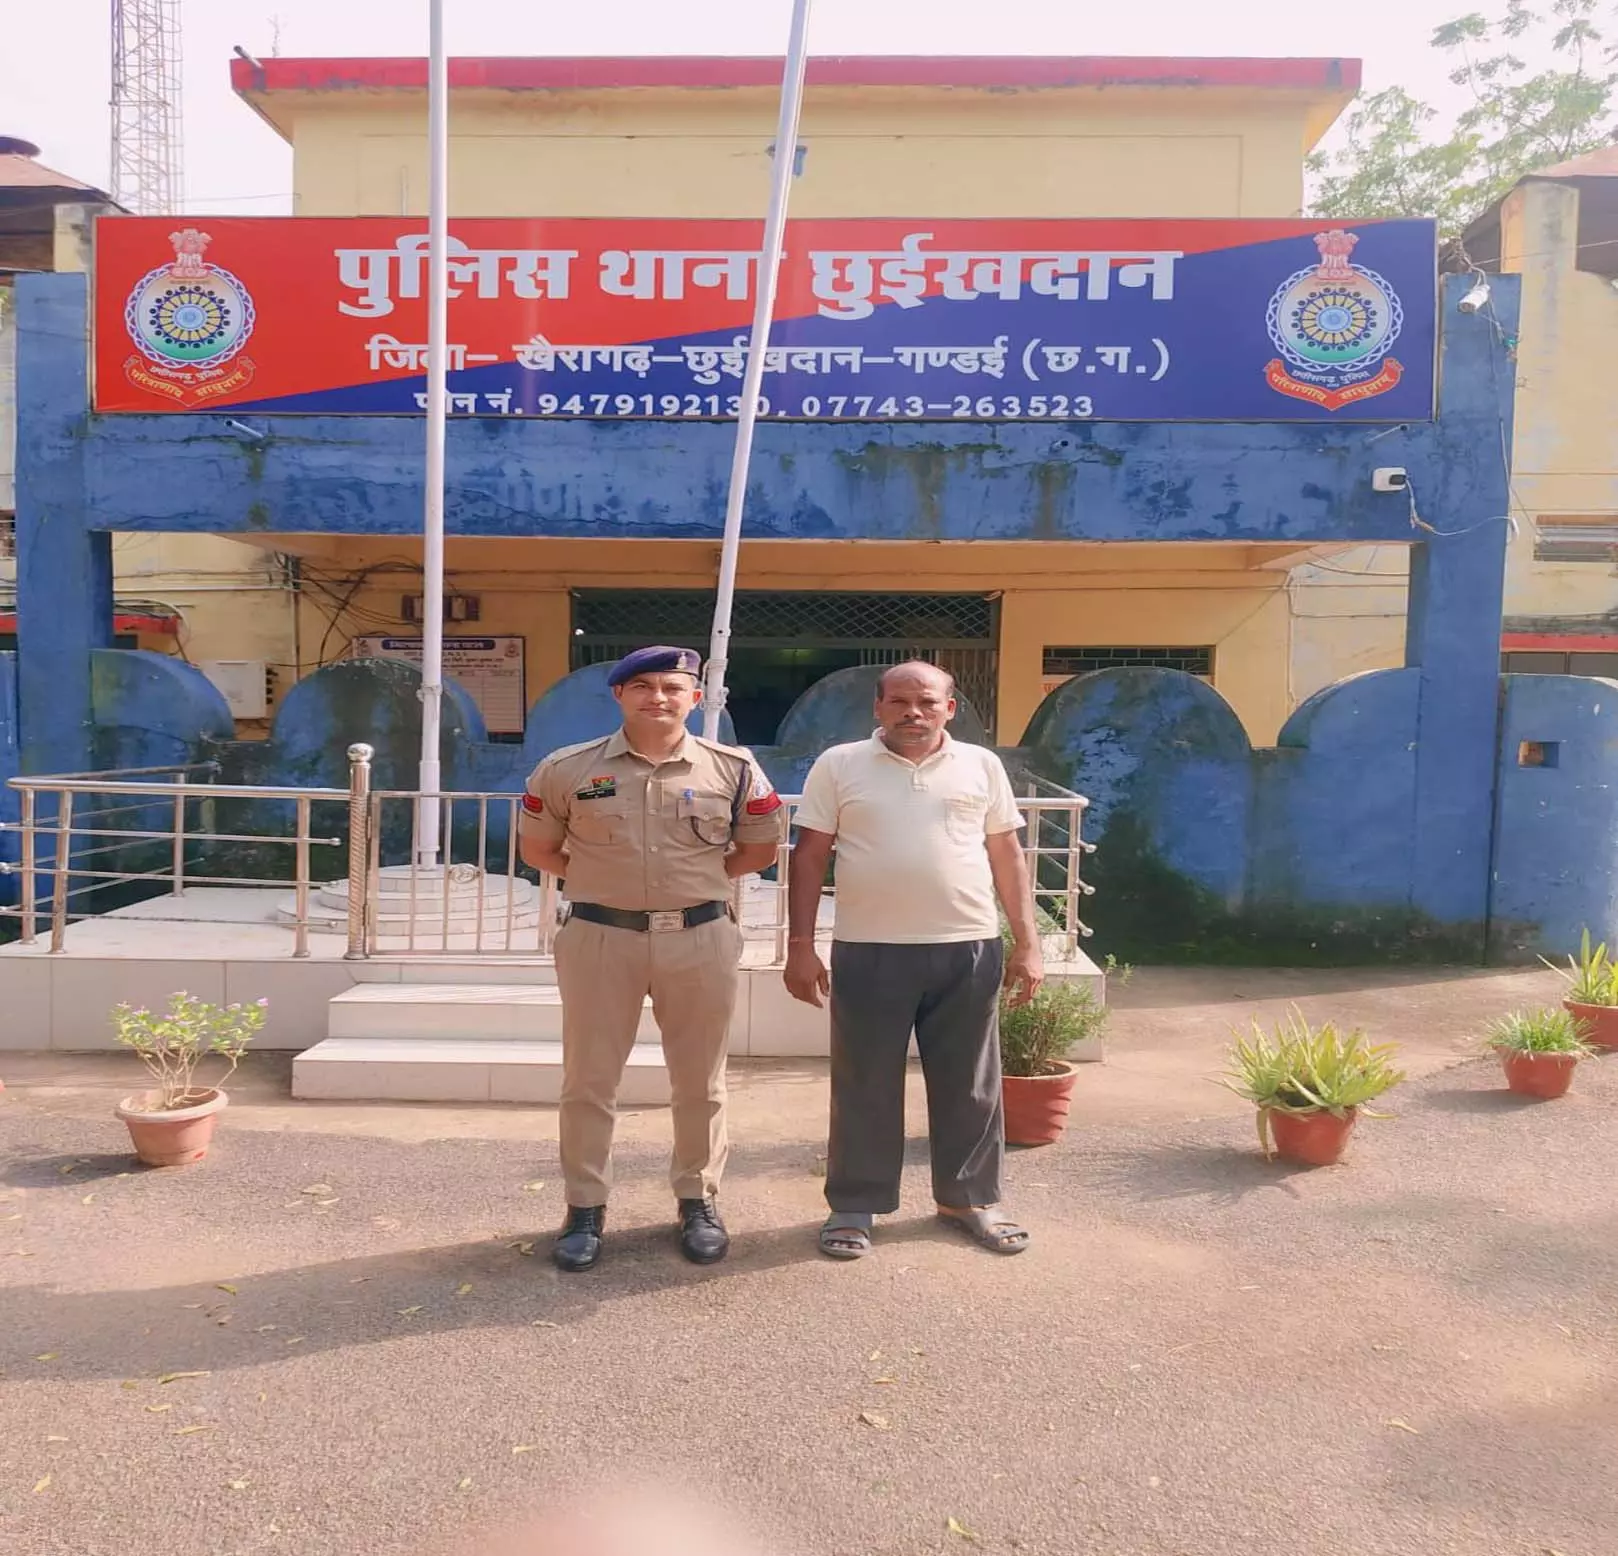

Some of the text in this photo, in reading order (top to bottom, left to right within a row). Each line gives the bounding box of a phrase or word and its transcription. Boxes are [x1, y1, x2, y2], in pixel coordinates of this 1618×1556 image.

[334, 232, 1184, 320] पुलिस थान छुईखदान
